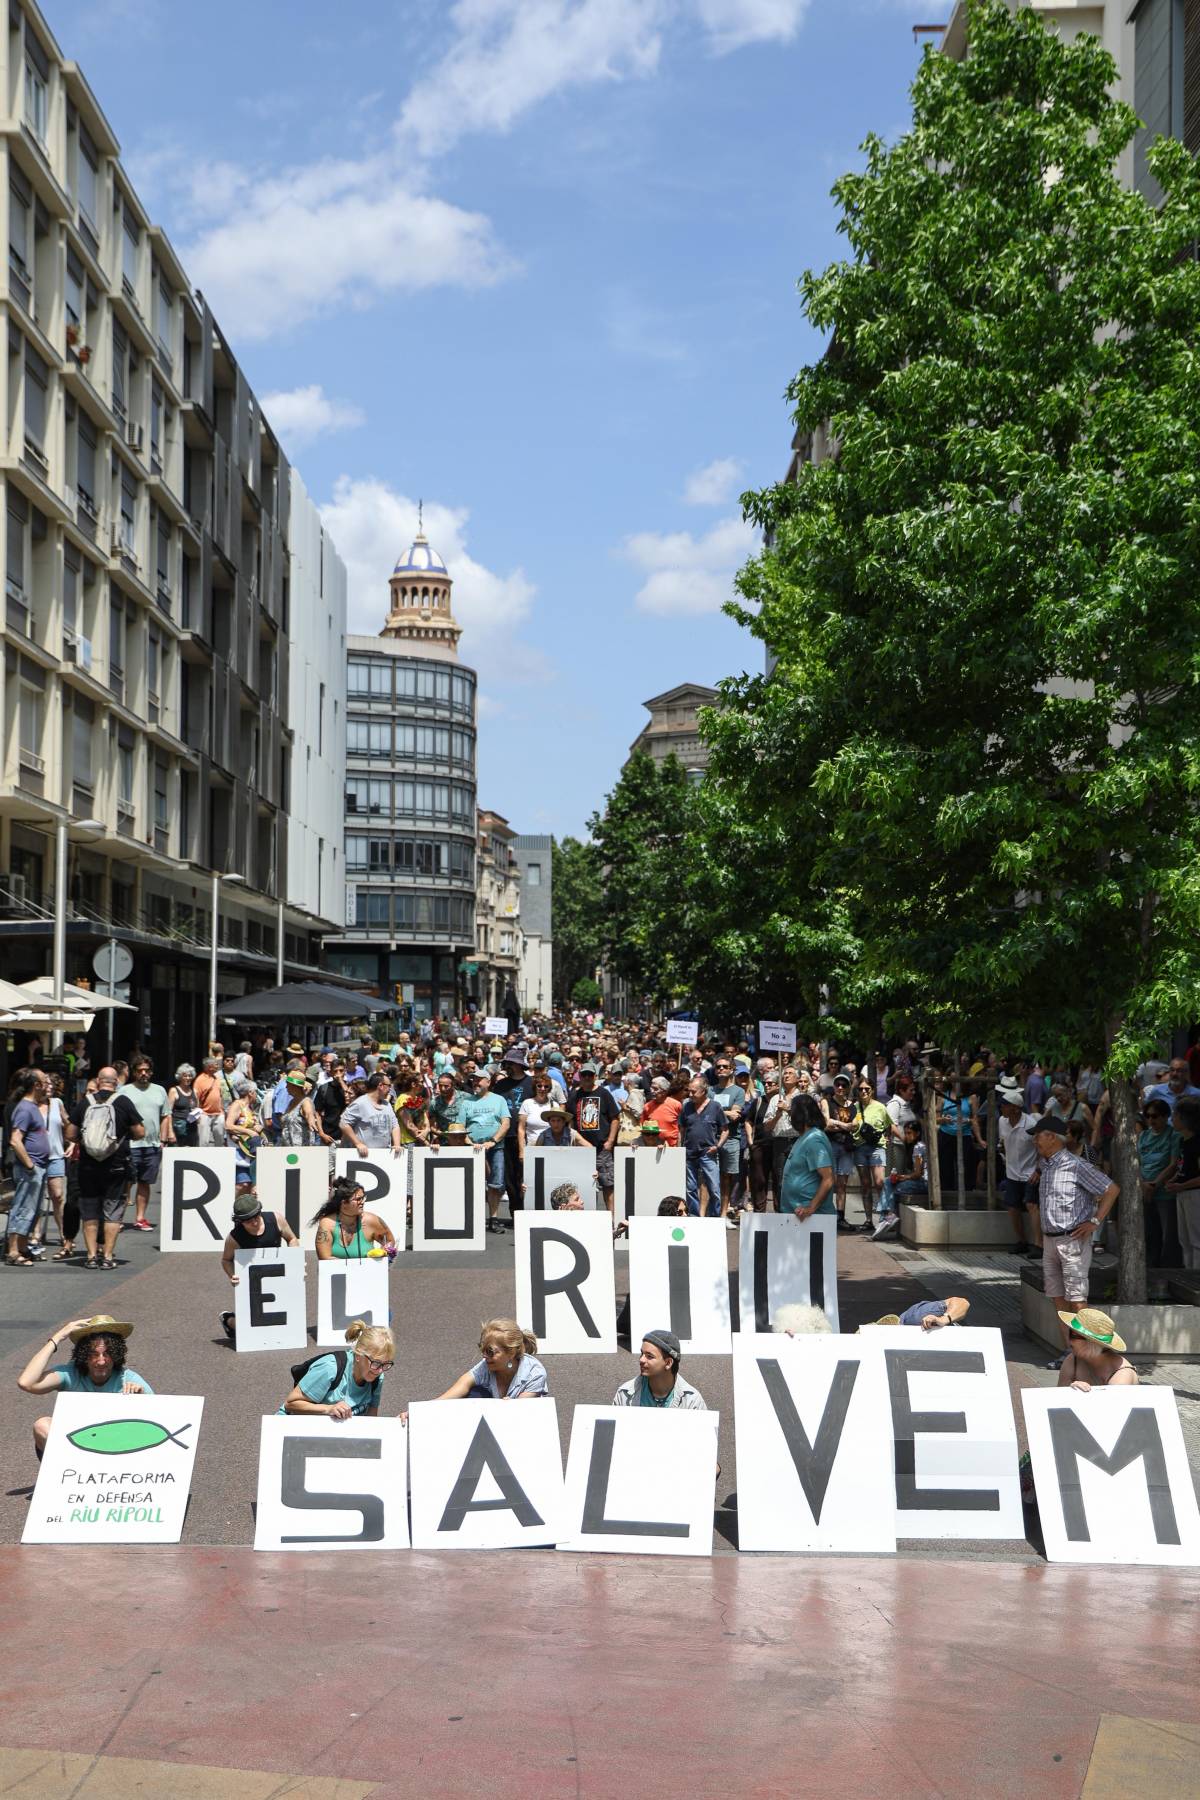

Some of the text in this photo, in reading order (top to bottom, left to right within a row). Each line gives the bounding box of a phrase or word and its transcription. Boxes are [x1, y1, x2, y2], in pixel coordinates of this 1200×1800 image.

[249, 1263, 373, 1330] EL
[280, 1349, 1182, 1545] SALVEM
[61, 1468, 175, 1485] PLATAFORMA
[68, 1492, 153, 1504] EN DEFENSA
[46, 1515, 64, 1523] DEL
